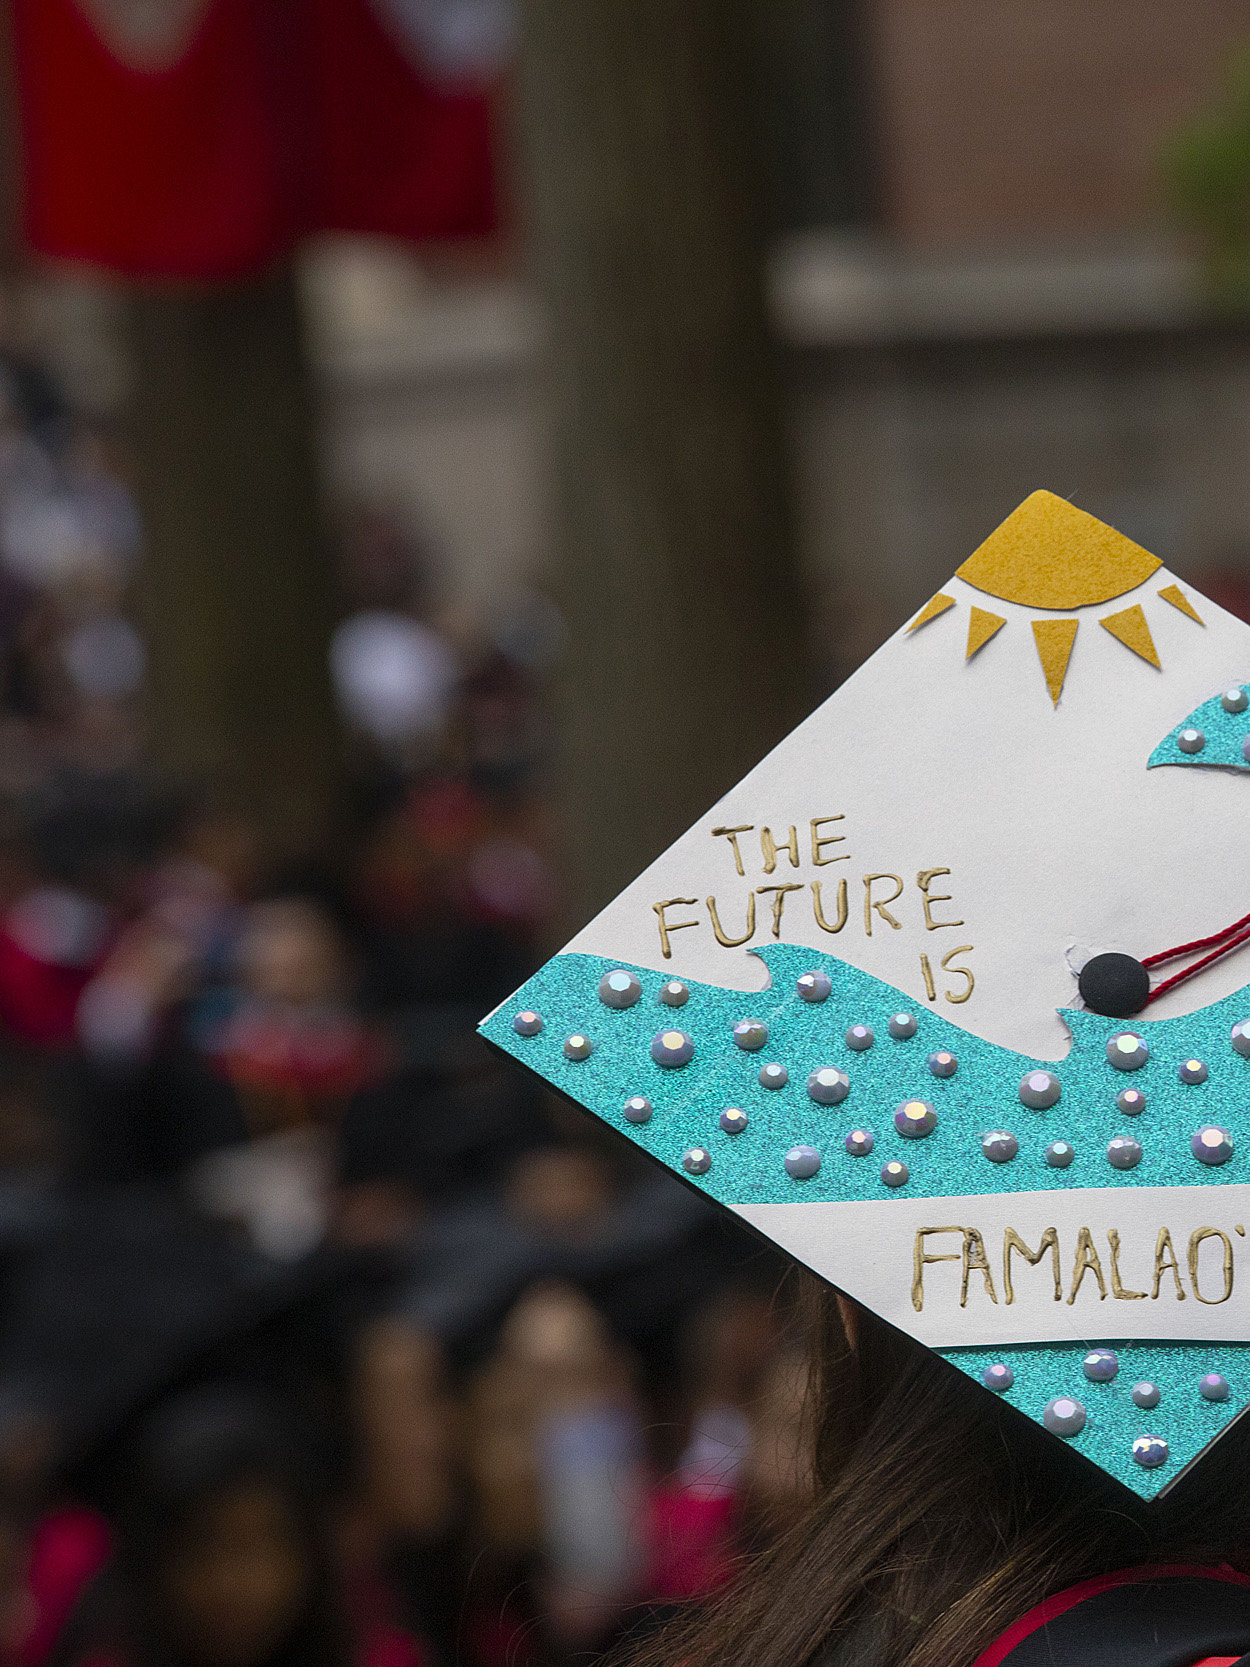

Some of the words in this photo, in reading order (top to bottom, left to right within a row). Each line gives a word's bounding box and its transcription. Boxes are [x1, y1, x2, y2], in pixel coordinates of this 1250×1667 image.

[711, 814, 851, 877] THE
[652, 867, 965, 960] FUTURE
[919, 945, 975, 1005] IS
